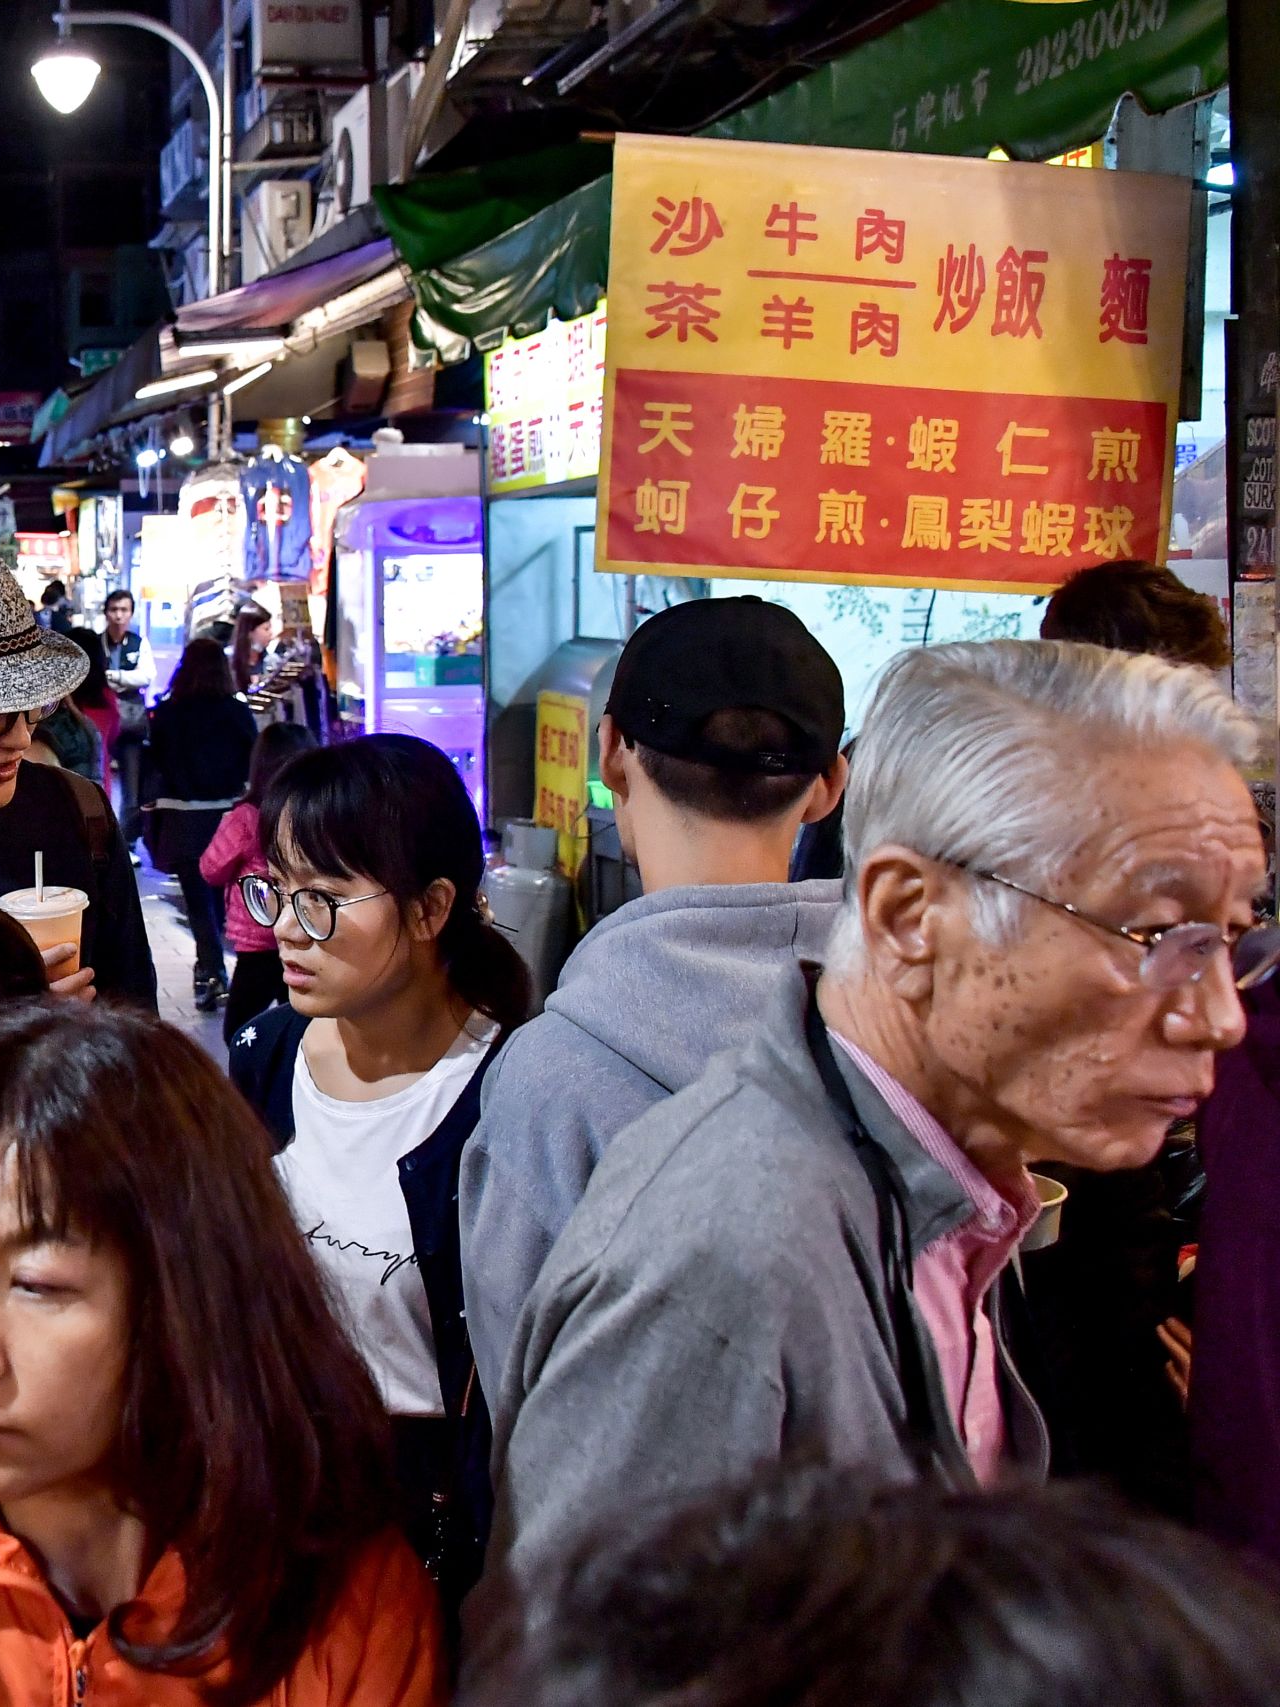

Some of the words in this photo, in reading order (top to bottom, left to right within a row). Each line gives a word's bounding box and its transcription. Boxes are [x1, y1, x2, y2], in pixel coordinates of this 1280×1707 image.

[645, 196, 724, 342] 沙茶
[764, 201, 906, 264] 牛肉
[760, 294, 900, 357] 羊肉
[933, 243, 1049, 340] 炒飯
[1098, 253, 1153, 345] 麵
